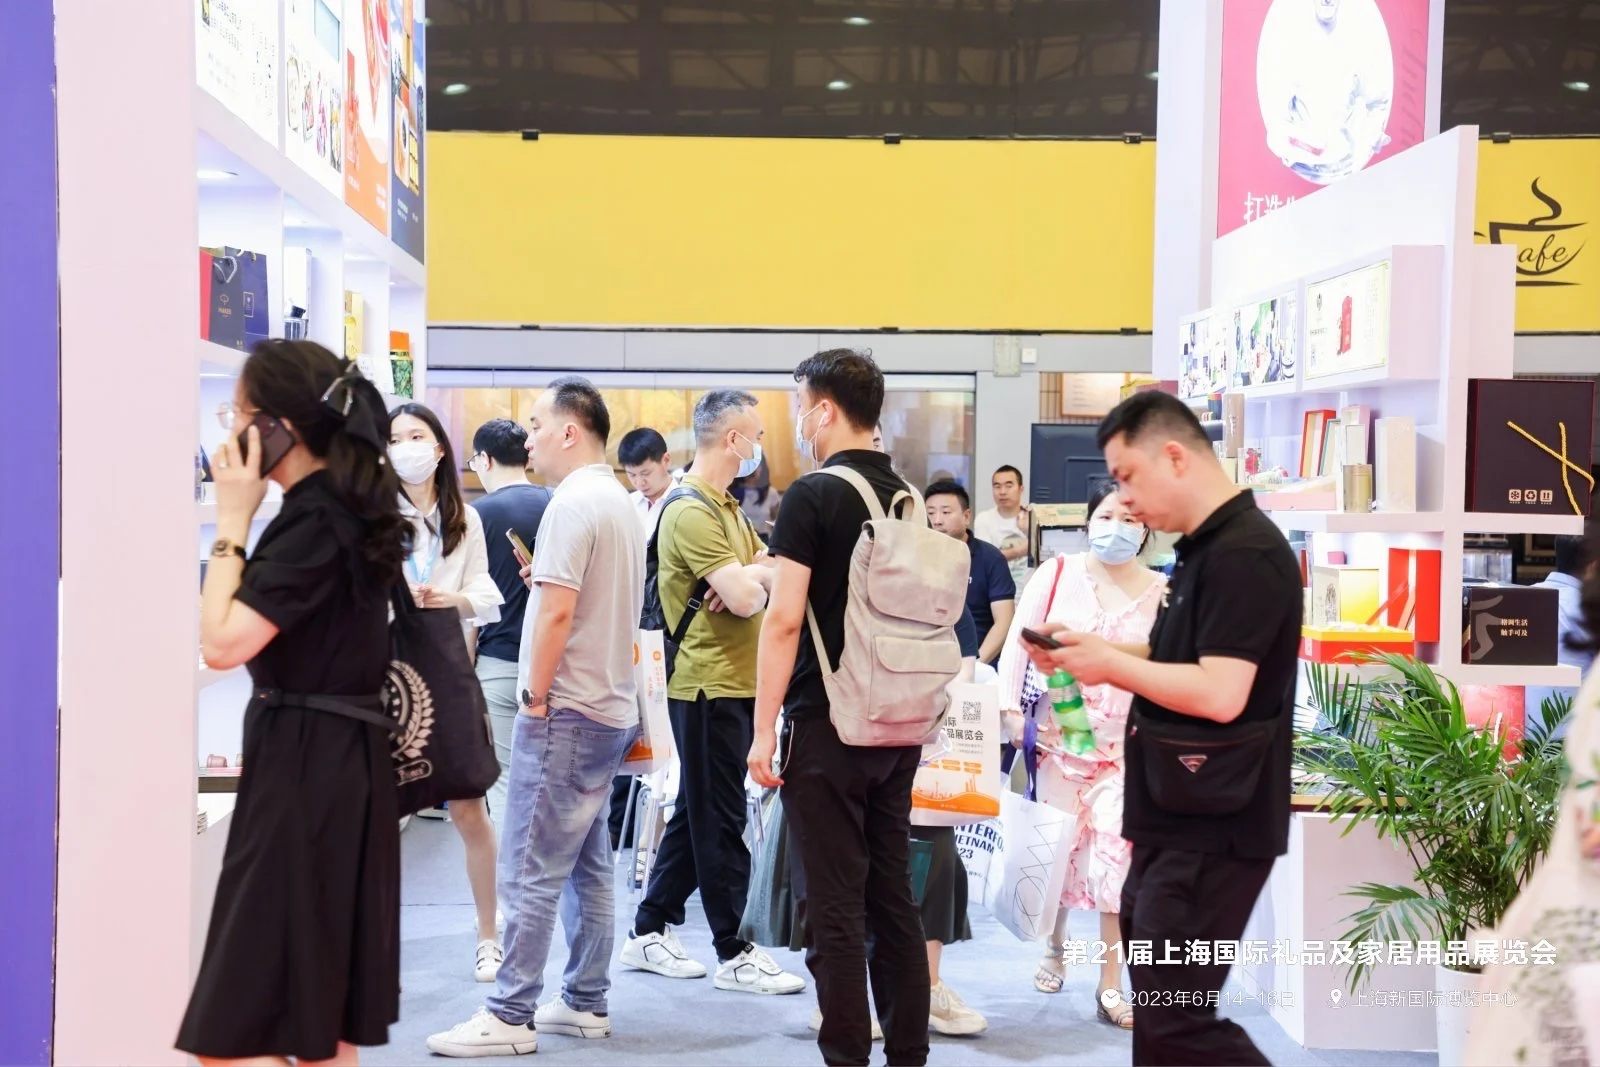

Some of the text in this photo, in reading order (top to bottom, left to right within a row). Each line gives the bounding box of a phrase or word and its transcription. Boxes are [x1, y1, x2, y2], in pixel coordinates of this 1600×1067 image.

[1243, 192, 1296, 223] 打造
[1515, 233, 1568, 272] afe
[944, 716, 957, 727] 际
[942, 727, 984, 741] 品展览会
[955, 834, 994, 855] IETNAM
[958, 847, 973, 859] 23
